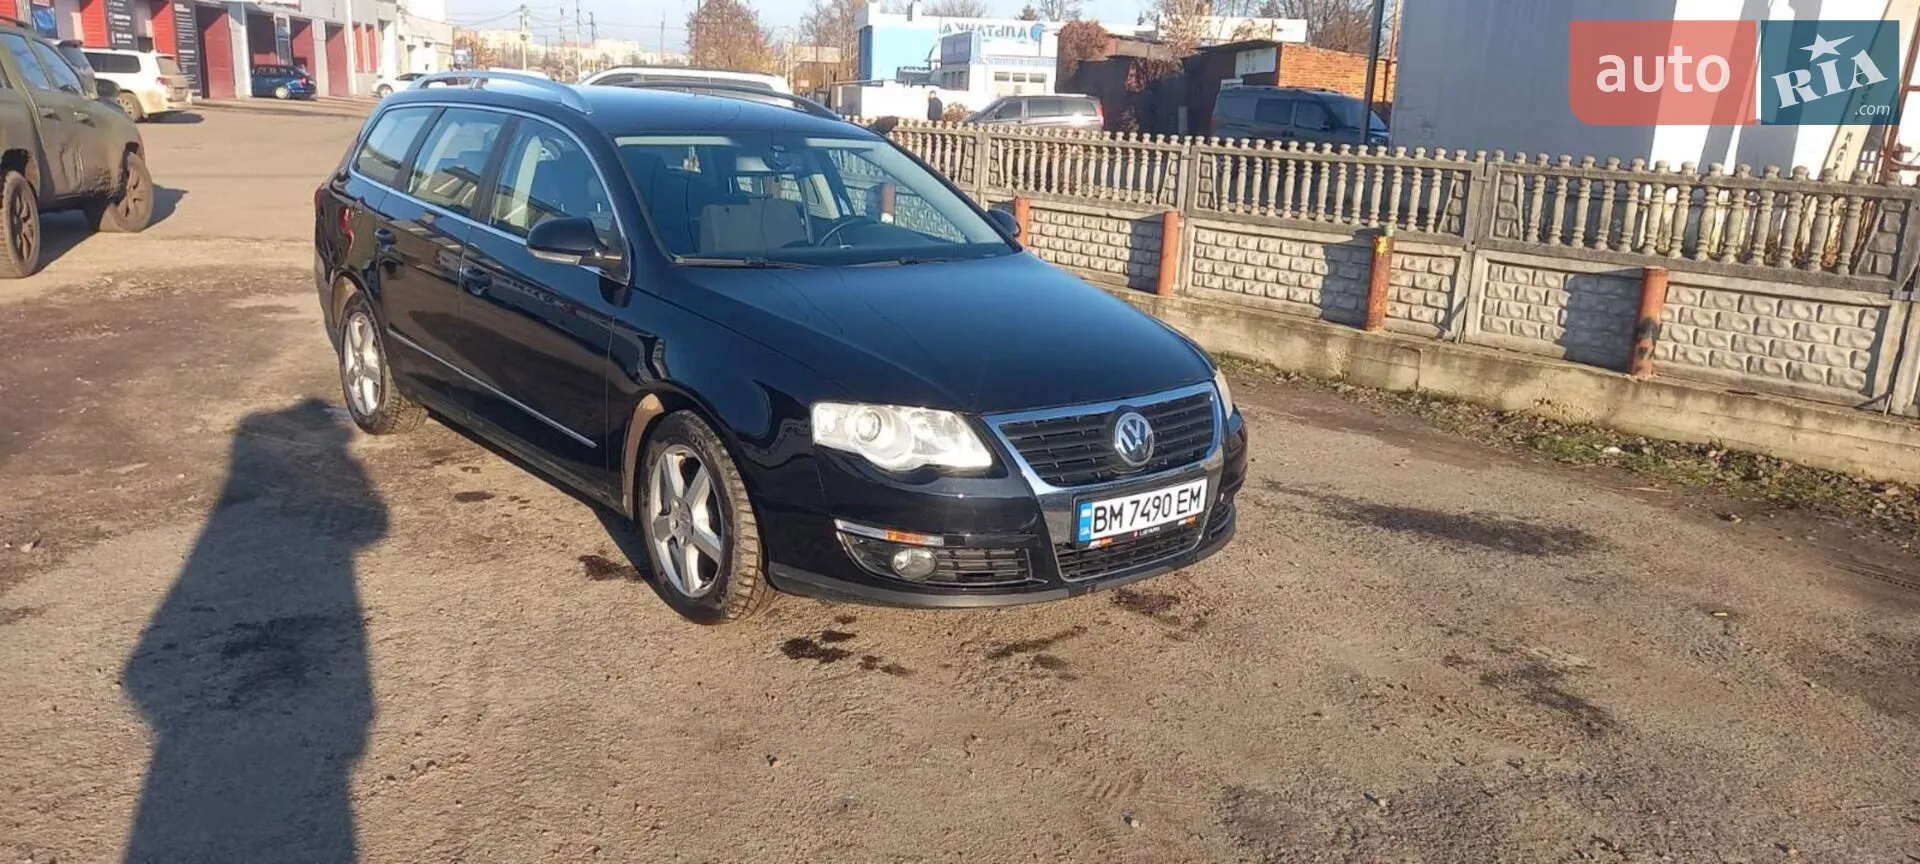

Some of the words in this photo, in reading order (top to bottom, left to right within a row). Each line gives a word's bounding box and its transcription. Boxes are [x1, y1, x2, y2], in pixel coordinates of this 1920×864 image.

[1093, 502, 1124, 533] BM
[1130, 493, 1172, 527] 7490
[1176, 486, 1201, 515] EM
